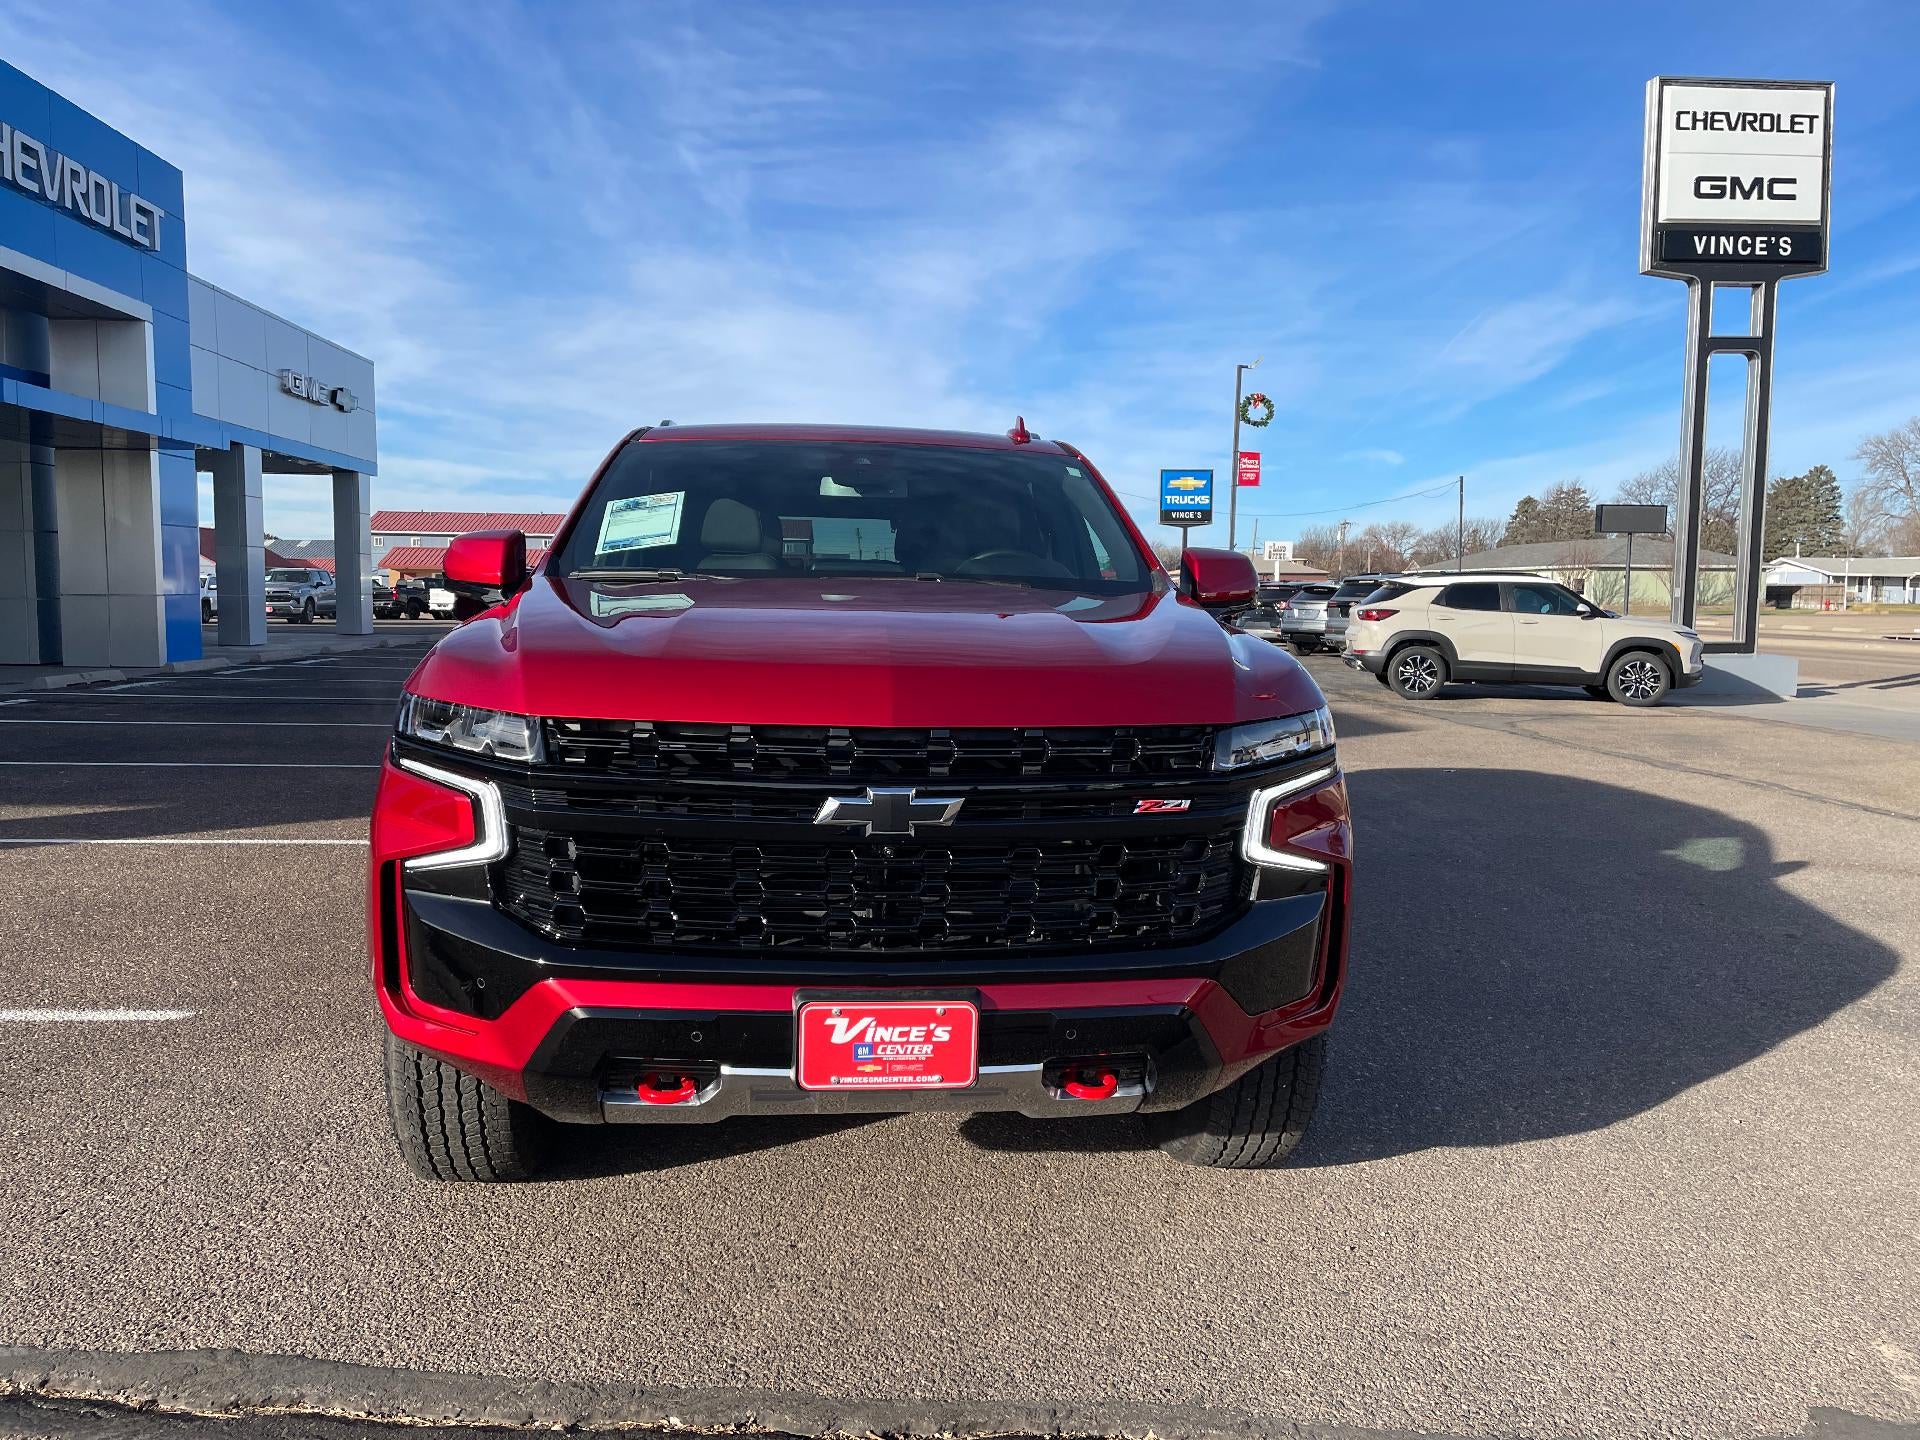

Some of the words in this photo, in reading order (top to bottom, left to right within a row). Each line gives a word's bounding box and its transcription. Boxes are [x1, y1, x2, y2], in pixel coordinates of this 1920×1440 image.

[1675, 110, 1819, 134] CHEVROLET
[1693, 175, 1798, 201] GMC
[1693, 235, 1792, 256] VINCE'S
[281, 368, 331, 406] GMC
[1165, 495, 1210, 505] TRUCKS
[1171, 511, 1202, 519] VINCE'S
[1132, 799, 1192, 814] Z71
[824, 1016, 953, 1045] VINCE'S
[857, 1047, 869, 1056] GM
[877, 1044, 934, 1055] CENTER
